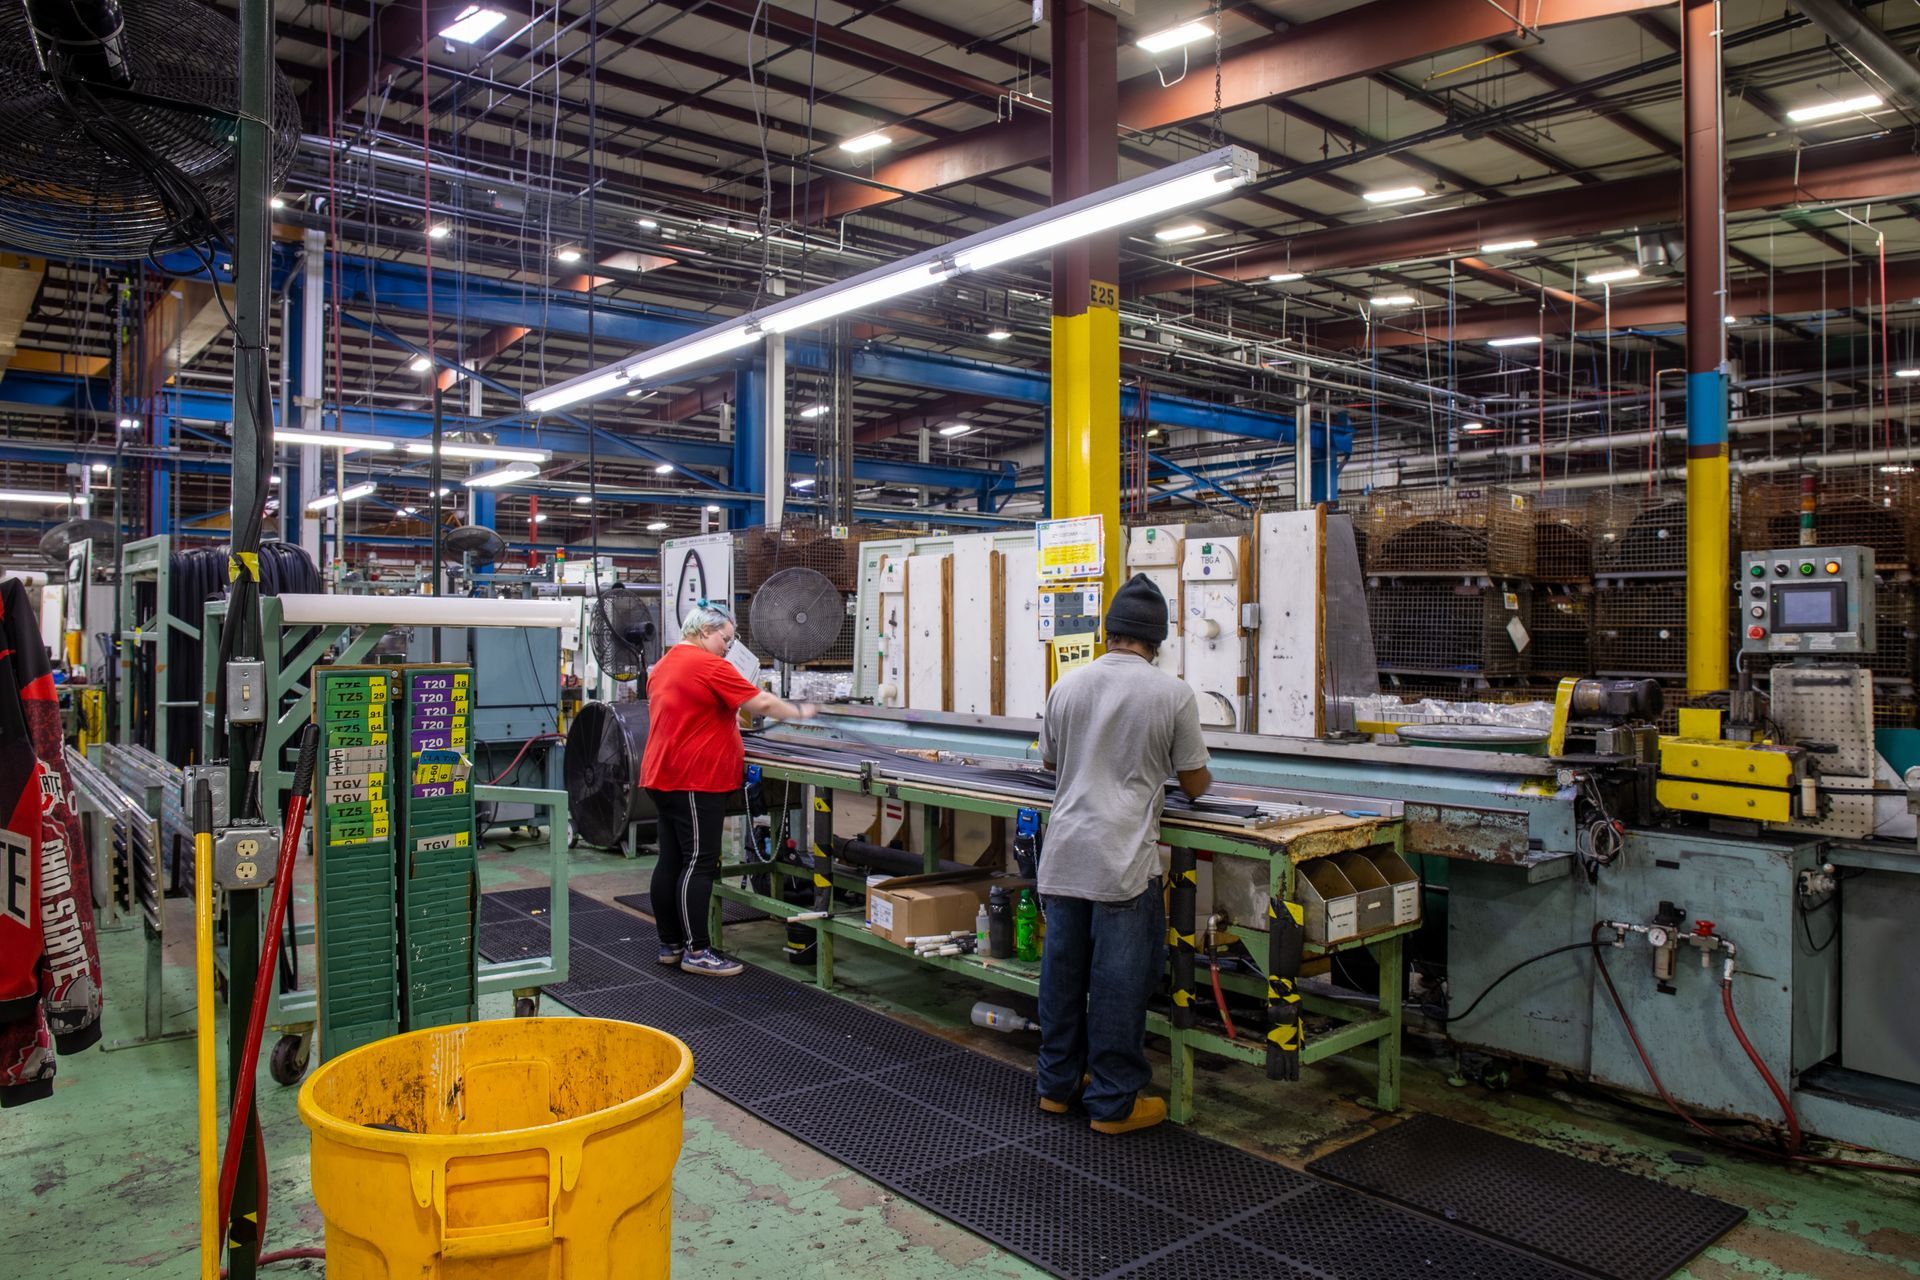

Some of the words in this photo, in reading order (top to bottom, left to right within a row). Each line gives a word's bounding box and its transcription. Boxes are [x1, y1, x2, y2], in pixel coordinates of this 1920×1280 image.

[1091, 284, 1114, 305] E25
[422, 679, 446, 689] T20
[337, 692, 363, 702] TZ5
[373, 692, 385, 700] 29
[420, 693, 443, 702] T20
[334, 709, 360, 719] TZ5
[424, 706, 448, 716] T20
[334, 723, 361, 733] TZ5
[421, 720, 444, 729] T20
[338, 736, 363, 746] TZ5
[420, 738, 444, 749] T20
[40, 774, 64, 802] ATE
[333, 779, 362, 790] TGV
[422, 787, 446, 798] T20
[333, 793, 362, 804] TGV
[337, 807, 363, 817] TZ5
[339, 827, 365, 837] TZ5
[424, 840, 450, 851] TGV
[41, 838, 72, 899] OHIO
[0, 840, 27, 921] E
[41, 897, 90, 987] STATE
